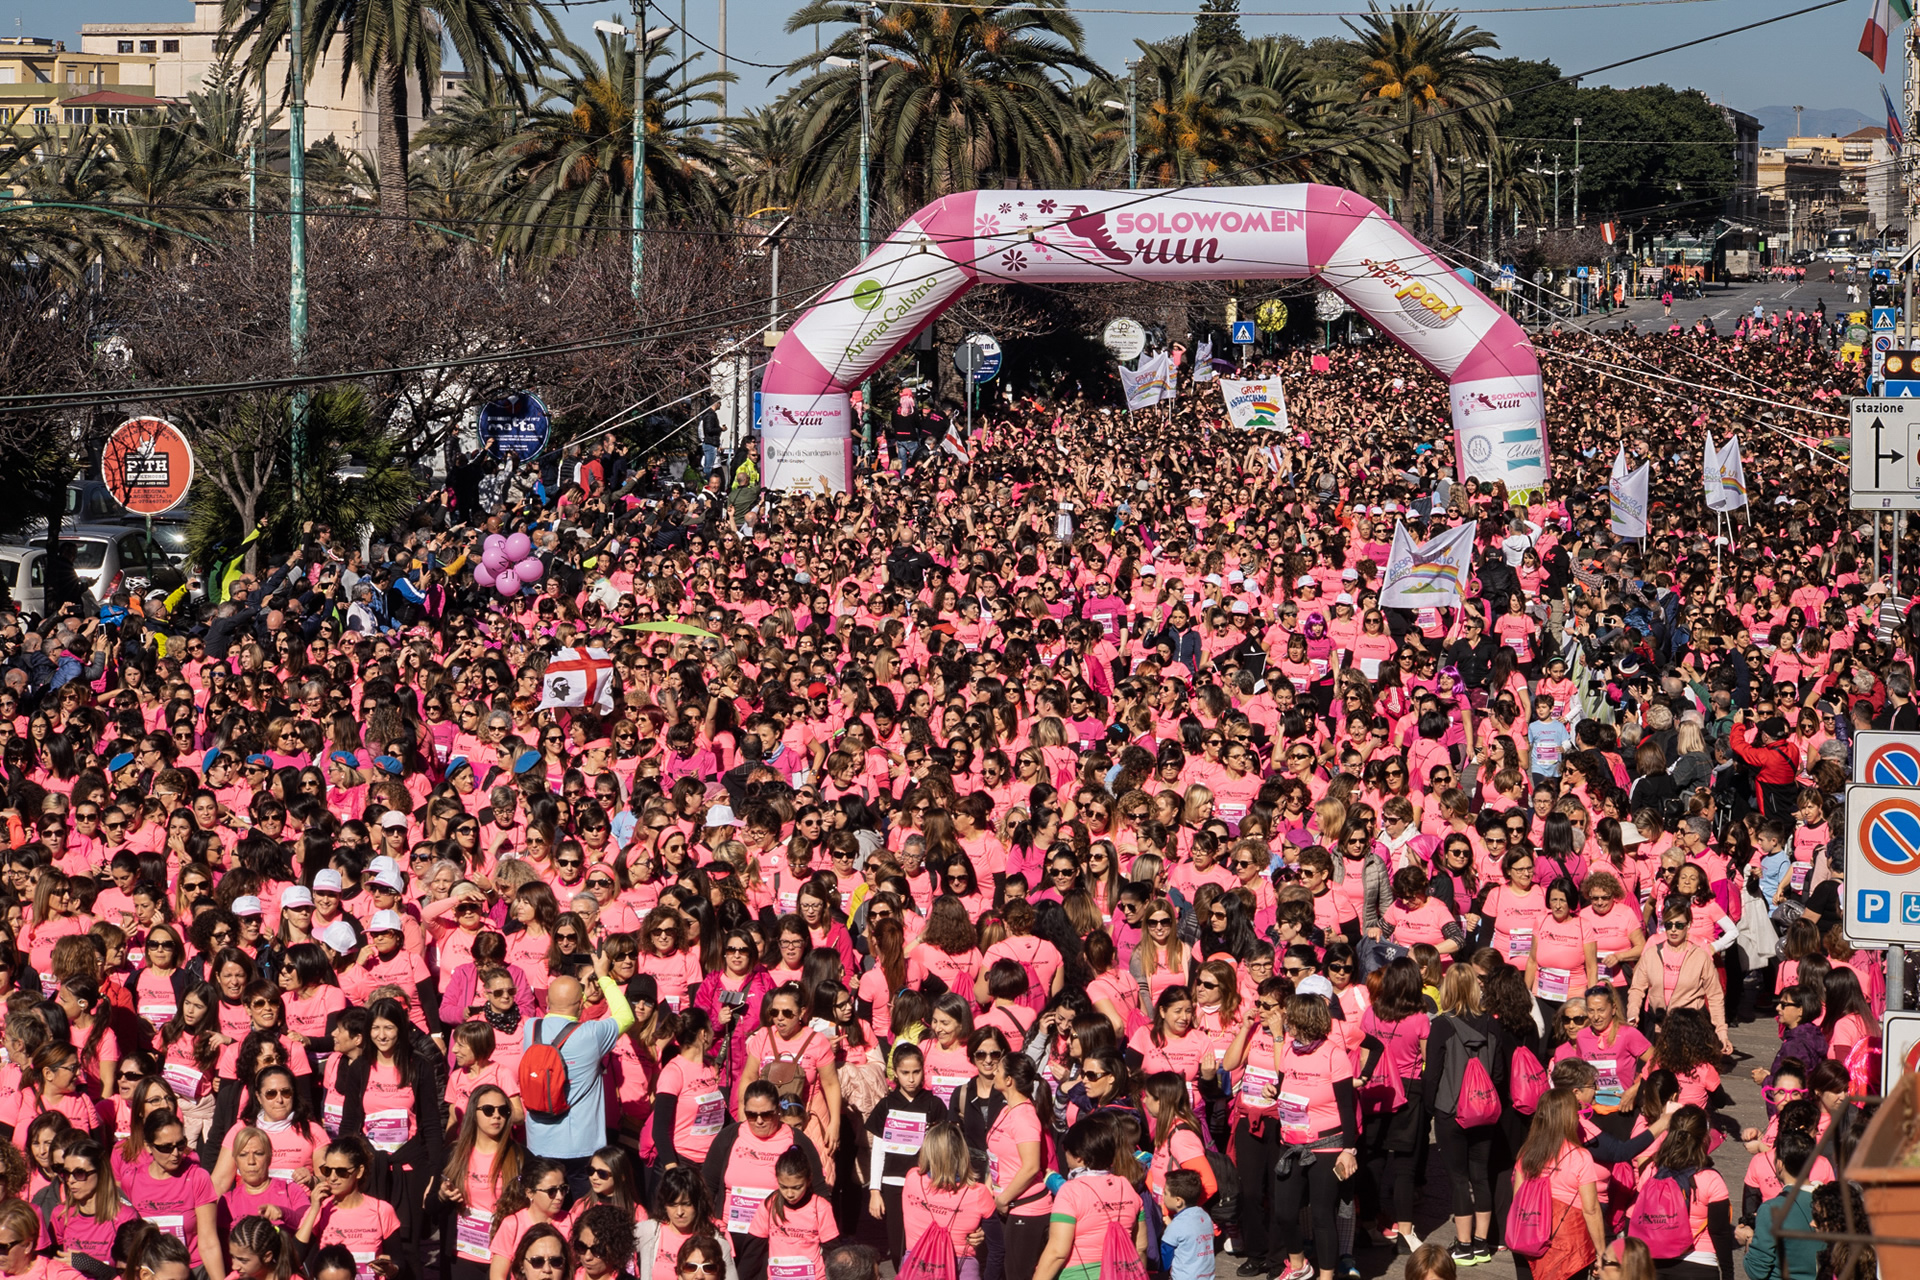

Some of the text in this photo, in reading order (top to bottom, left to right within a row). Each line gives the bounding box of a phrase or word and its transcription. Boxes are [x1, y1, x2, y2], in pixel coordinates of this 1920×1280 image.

[1116, 210, 1304, 235] SOLOWOMEN
[1131, 236, 1224, 264] run
[1241, 385, 1267, 395] GRUPPO
[1491, 391, 1537, 401] SOLOWOMEN
[1496, 399, 1521, 409] run
[1855, 402, 1904, 413] stazione
[799, 417, 823, 426] run
[1389, 556, 1454, 578] ABBRAAMO
[1864, 902, 1884, 919] P
